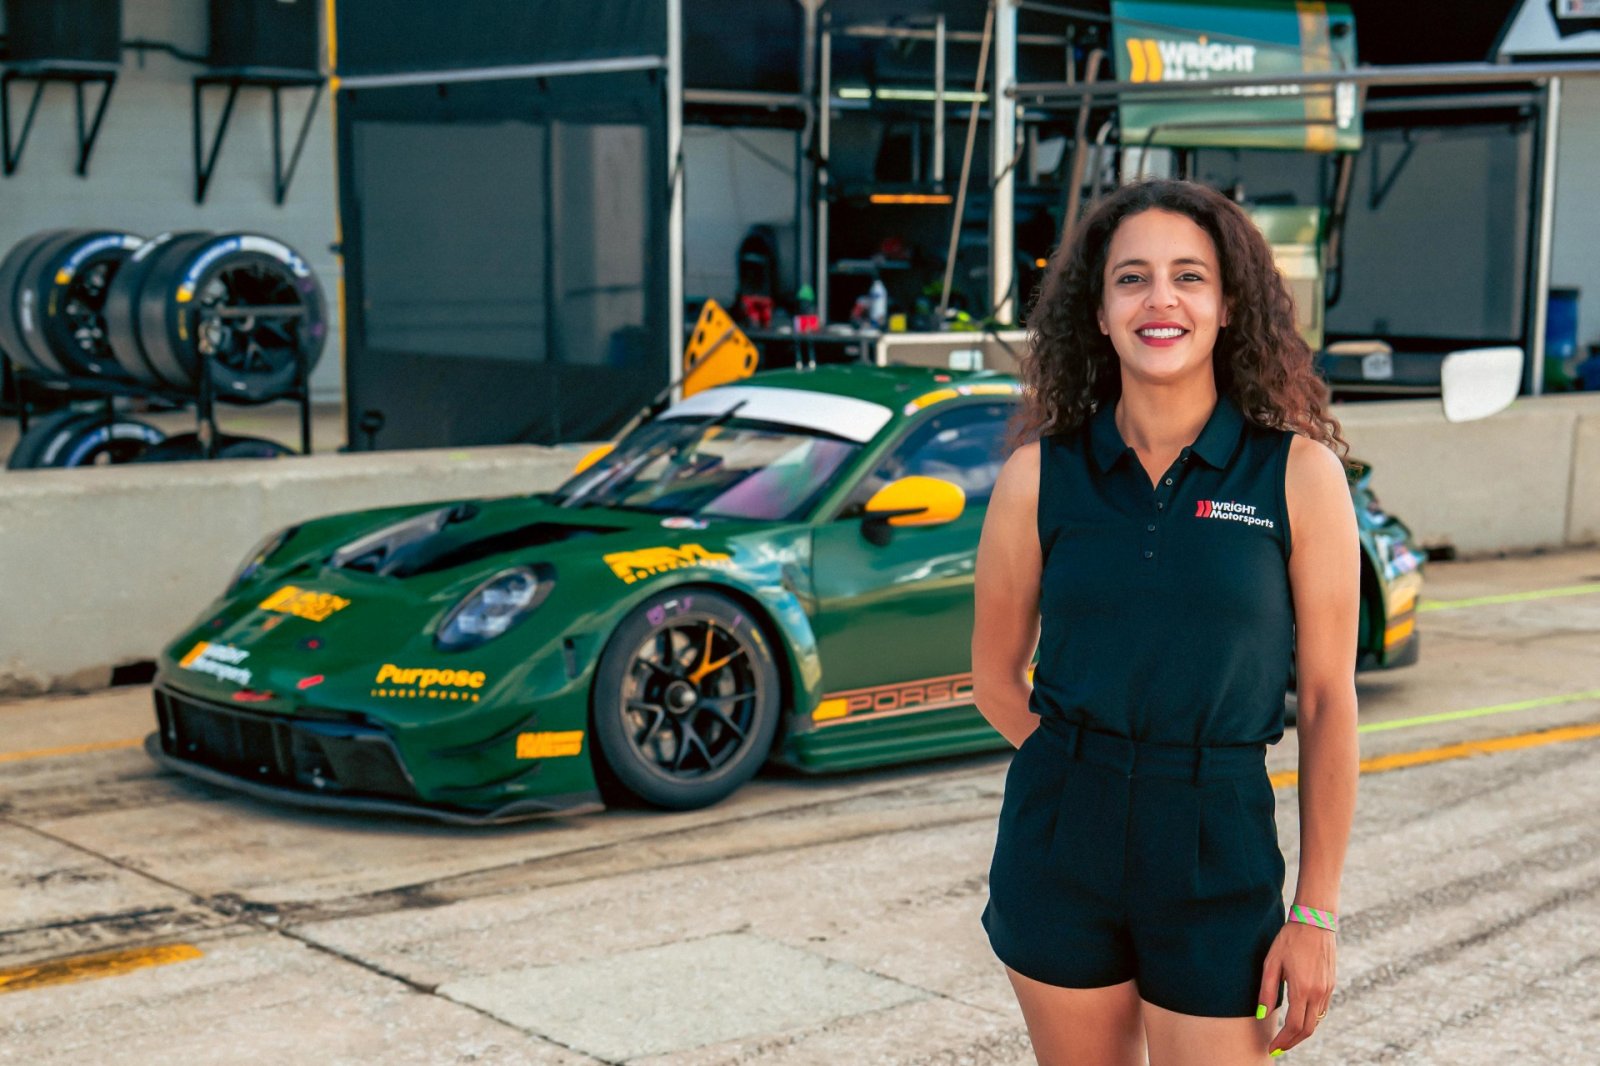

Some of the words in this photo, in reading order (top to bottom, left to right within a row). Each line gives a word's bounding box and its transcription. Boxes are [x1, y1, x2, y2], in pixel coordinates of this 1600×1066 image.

[1210, 510, 1274, 528] Motorsports
[375, 663, 486, 688] Purpose
[849, 680, 973, 714] PORSC
